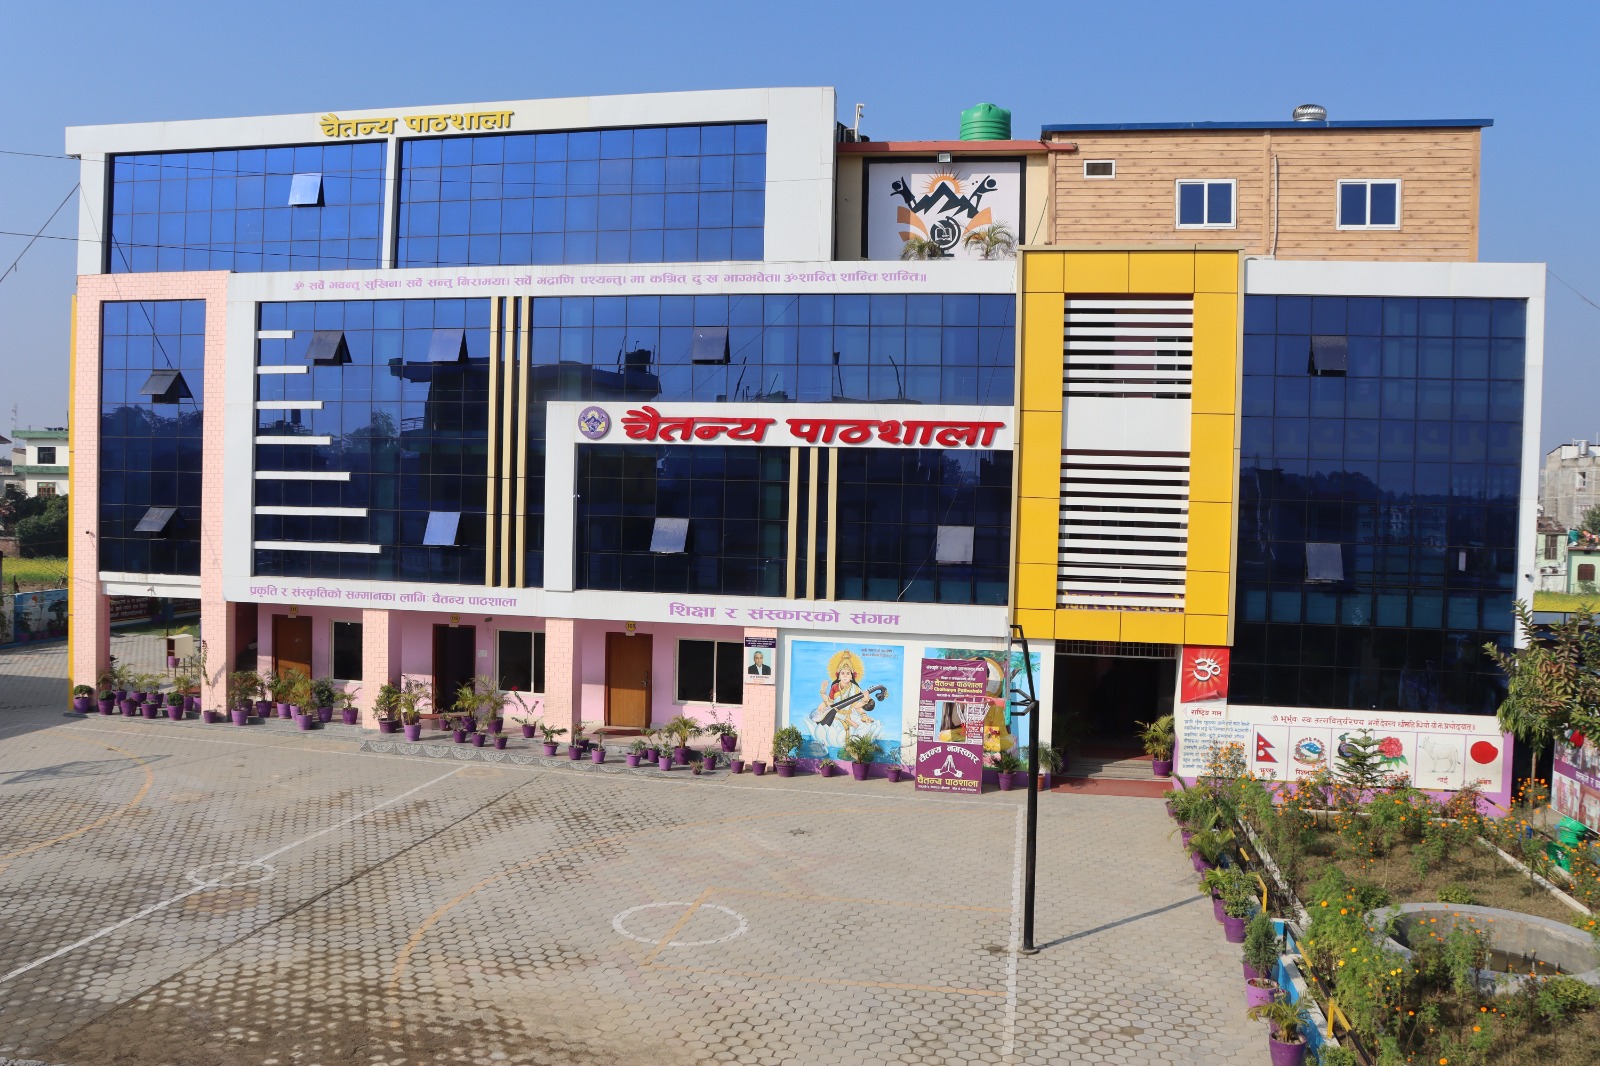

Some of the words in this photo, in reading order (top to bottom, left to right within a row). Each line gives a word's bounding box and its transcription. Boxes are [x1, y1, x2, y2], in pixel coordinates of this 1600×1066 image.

[319, 113, 398, 137] चैतन्य
[403, 111, 514, 133] पाठशाला
[329, 280, 360, 291] भवन्तु
[428, 277, 453, 289] सन्तु
[537, 273, 575, 286] भद्राणि
[630, 274, 645, 285] मा
[621, 405, 777, 442] चैतन्य
[786, 417, 1006, 447] पाठशाला
[250, 585, 278, 598] प्रकृति
[281, 587, 289, 597] र
[291, 586, 342, 600] संस्कृतिको
[345, 590, 396, 602] सम्मानका
[432, 592, 466, 605] चैतन्य
[468, 596, 518, 607] पाठशाला
[669, 601, 716, 618] शिक्षा
[725, 607, 739, 619] र
[748, 606, 841, 623] संस्कारको
[850, 611, 901, 625] संगम
[945, 778, 980, 788] पाठशाला
